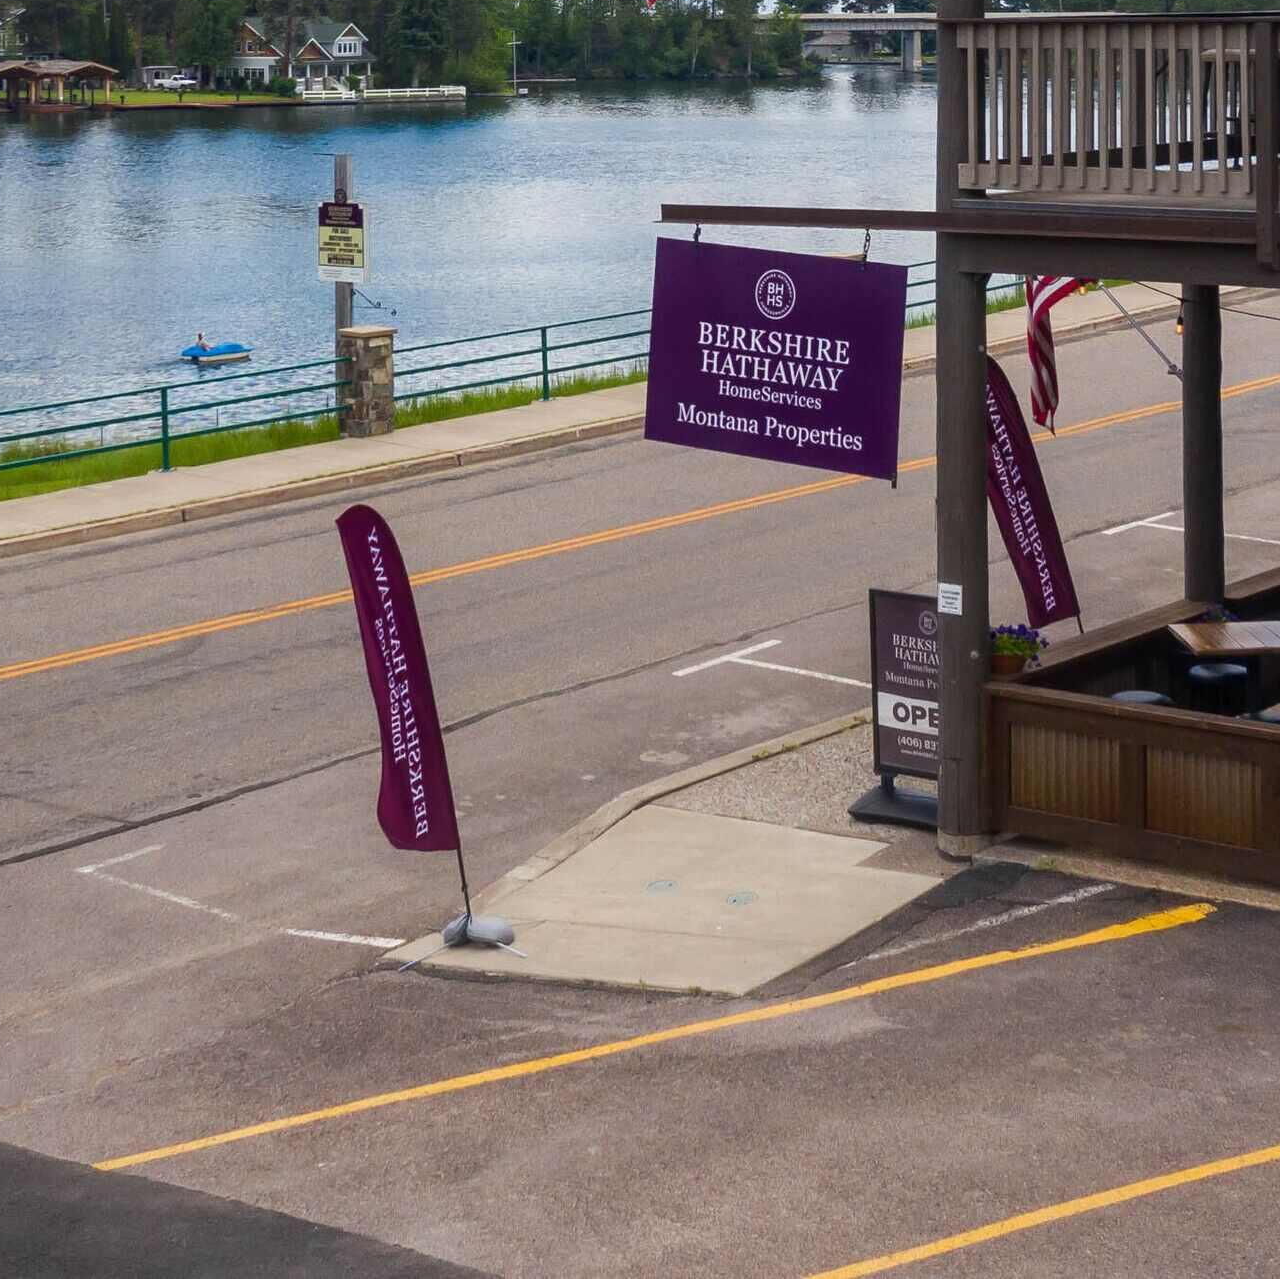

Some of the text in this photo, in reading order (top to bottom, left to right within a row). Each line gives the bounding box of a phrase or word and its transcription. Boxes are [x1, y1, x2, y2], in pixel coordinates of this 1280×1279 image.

[767, 282, 784, 295] BH
[766, 294, 783, 307] HS
[698, 321, 850, 365] BERKSHIRE
[700, 350, 843, 392] HATHAWAY
[719, 379, 822, 410] HomeServices
[677, 402, 863, 452] Montana Properties
[892, 634, 937, 653] BERKS
[895, 647, 939, 666] HATHA
[885, 671, 924, 687] Montana
[892, 702, 938, 729] OPE
[897, 735, 922, 750] (406)
